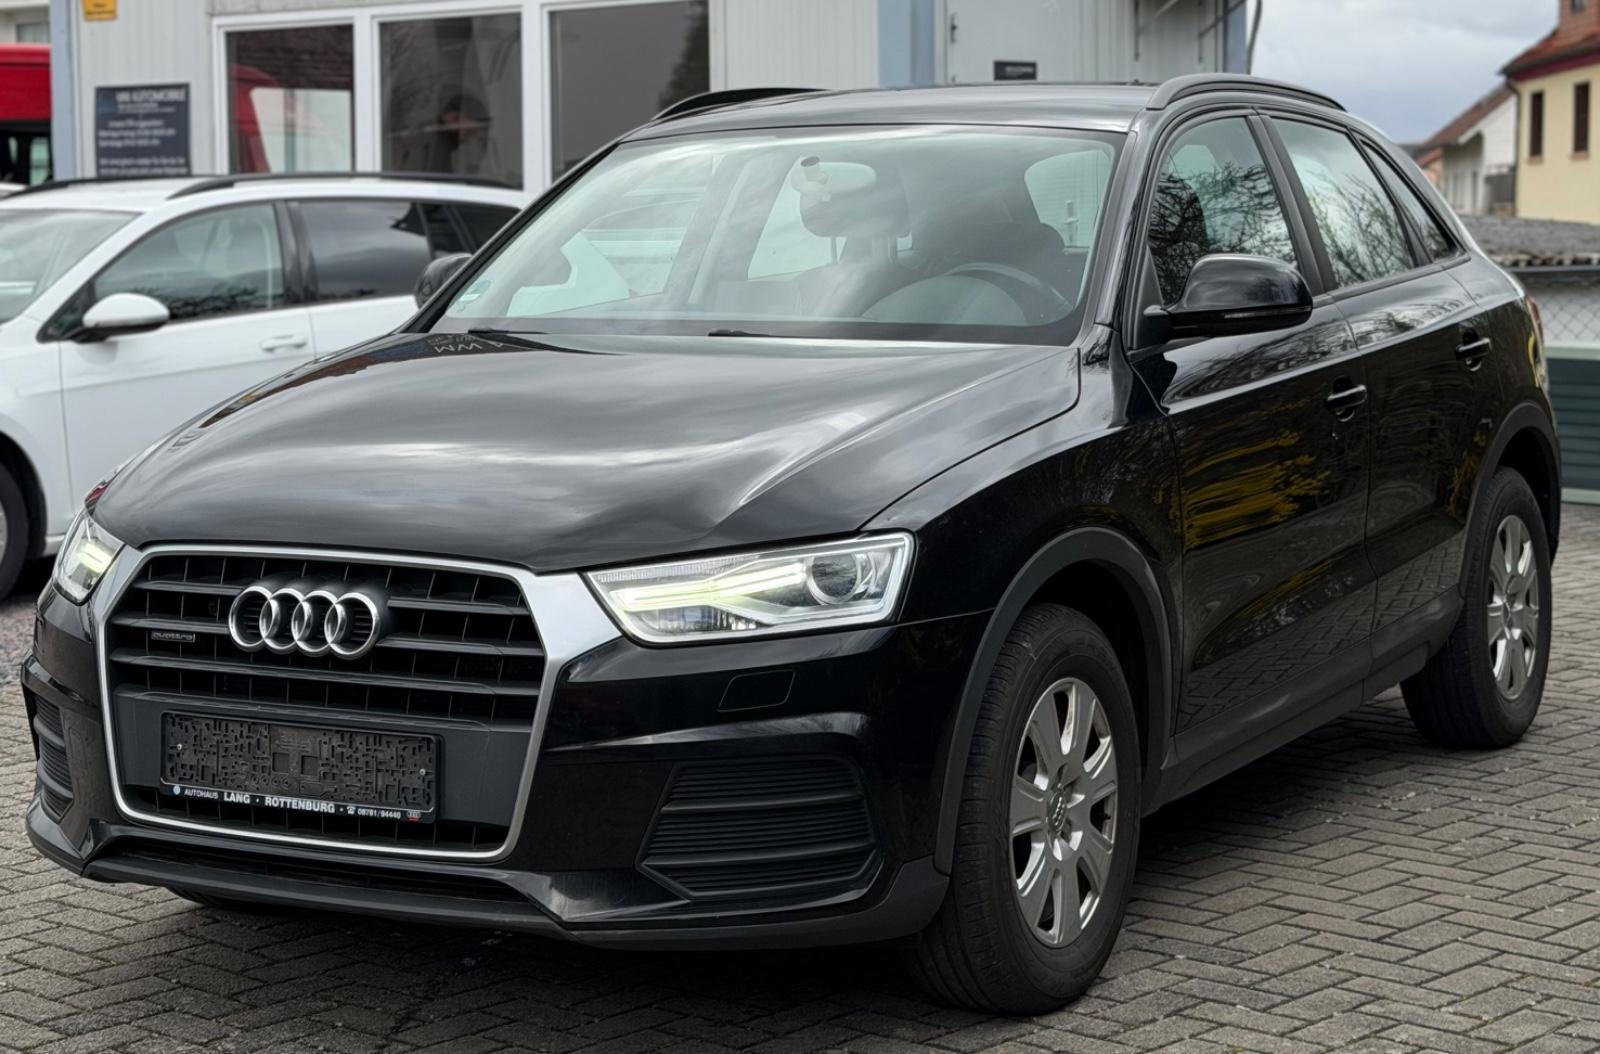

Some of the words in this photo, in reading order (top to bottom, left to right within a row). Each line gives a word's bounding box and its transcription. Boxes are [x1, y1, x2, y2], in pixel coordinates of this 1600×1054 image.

[152, 632, 193, 641] quattro
[184, 788, 219, 799] AUTOHAUS
[224, 792, 250, 804] LANG
[265, 797, 335, 813] ROTTENBURG
